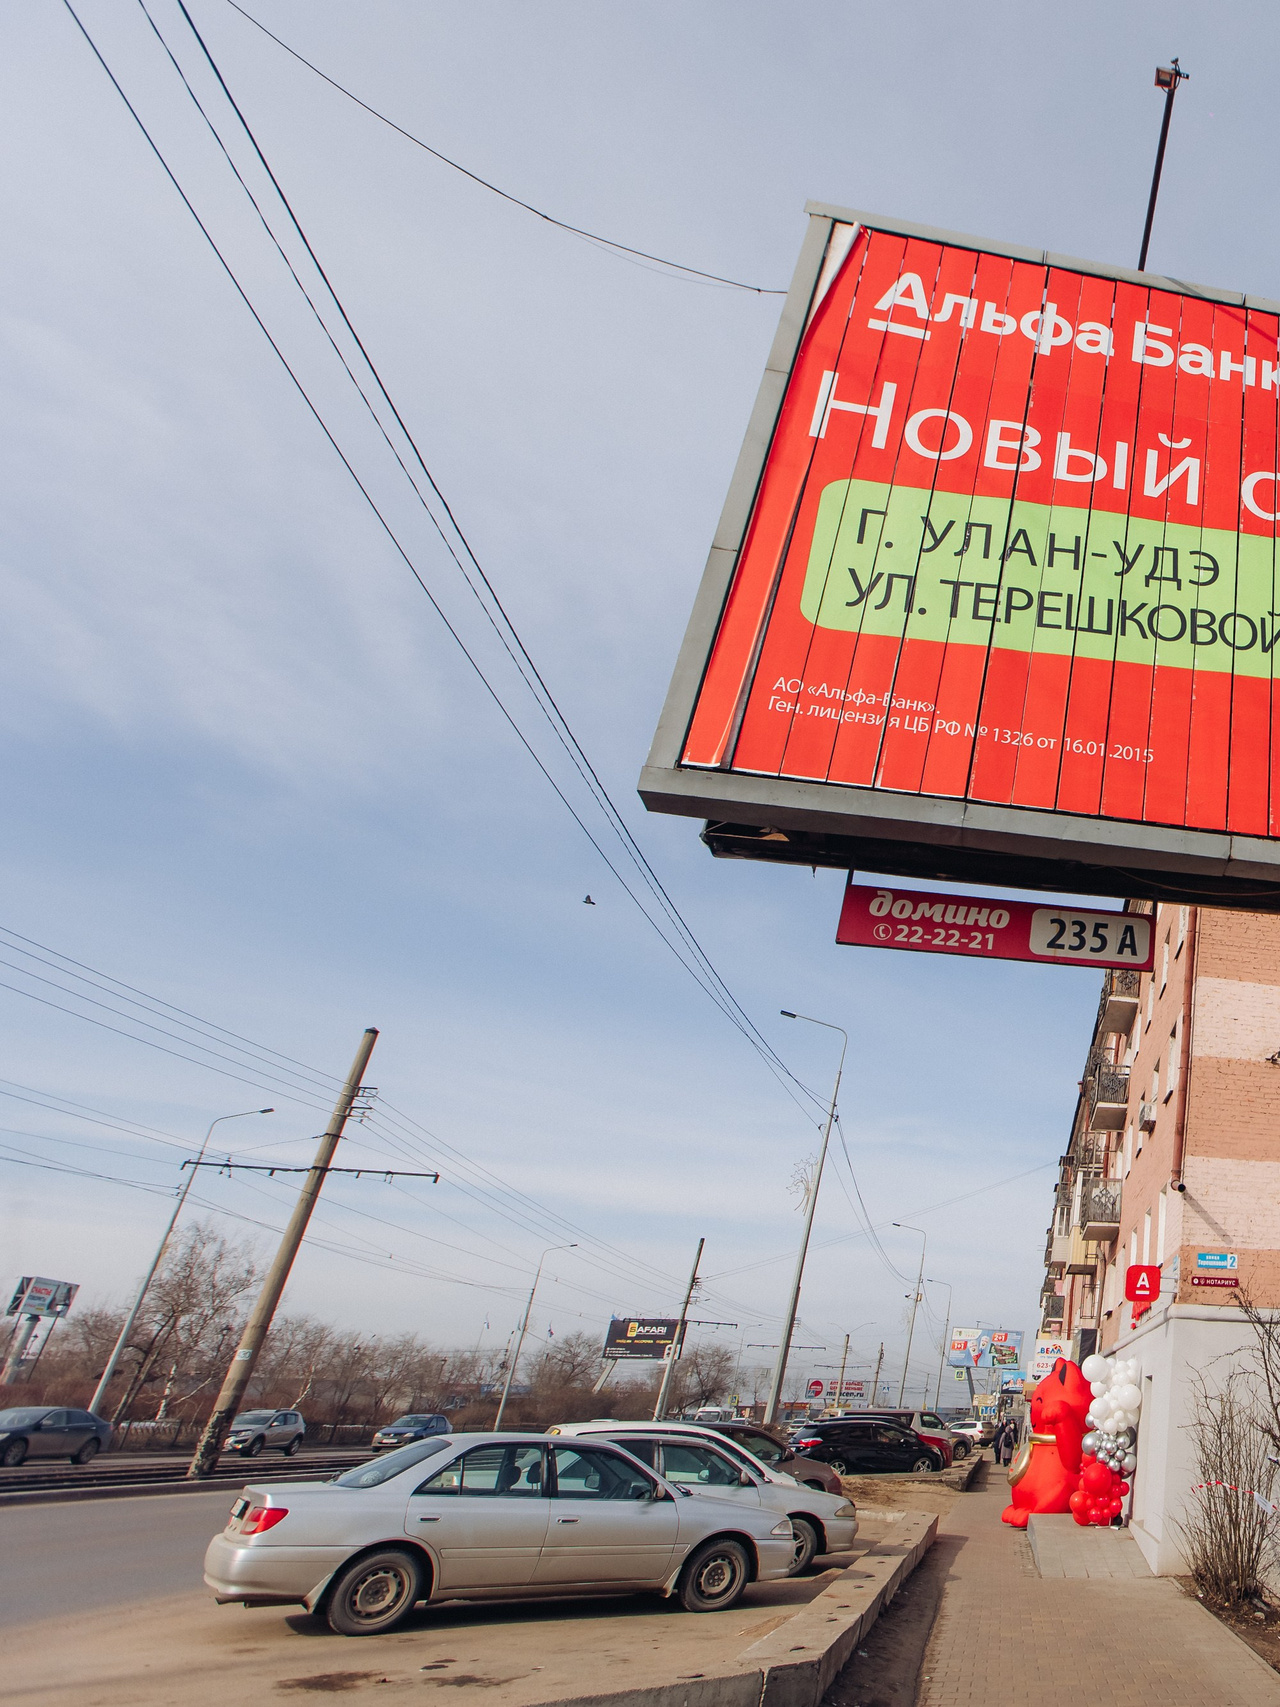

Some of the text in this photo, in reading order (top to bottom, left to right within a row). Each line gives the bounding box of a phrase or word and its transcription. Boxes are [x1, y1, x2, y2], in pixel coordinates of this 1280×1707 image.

[868, 271, 1115, 357] Альфа
[808, 369, 1201, 507] Новый
[920, 515, 1221, 588] УЛАН-УДЭ
[844, 567, 927, 617] УЛ.
[772, 676, 804, 694] АО
[767, 695, 804, 715] Ген.
[806, 704, 901, 728] лицензия
[903, 715, 930, 734] ЦБ
[934, 719, 962, 737] РФ
[992, 727, 1034, 747] 1326
[1036, 737, 1058, 750] от
[1063, 737, 1155, 764] 16.01.2015
[868, 890, 1010, 929] домино
[894, 924, 995, 951] 22-22-21
[1046, 917, 1110, 954] 235
[1229, 1255, 1237, 1268] 2
